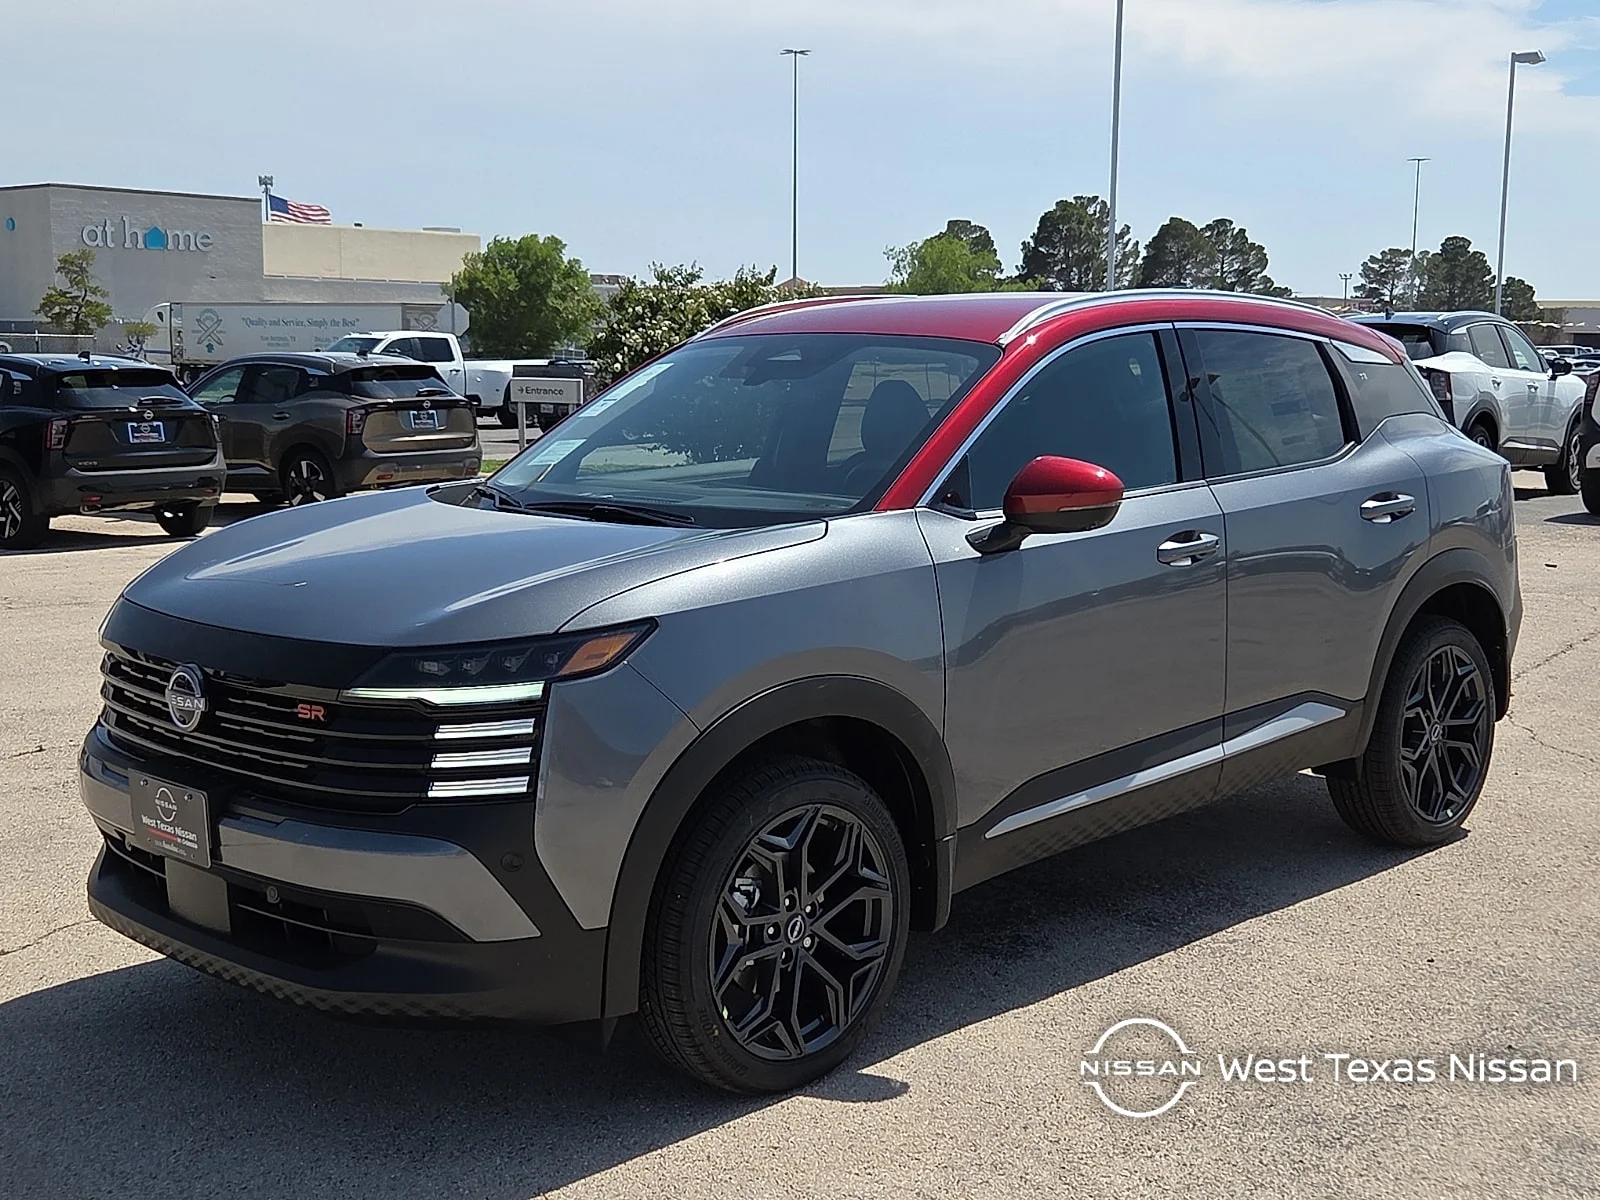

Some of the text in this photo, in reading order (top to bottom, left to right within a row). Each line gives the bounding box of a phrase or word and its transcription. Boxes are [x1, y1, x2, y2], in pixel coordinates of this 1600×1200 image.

[81, 217, 116, 248] at
[268, 317, 281, 327] and
[306, 317, 329, 329] Simply
[329, 316, 341, 327] the
[525, 386, 564, 396] Entrance
[297, 703, 327, 722] SR
[155, 798, 177, 811] NISSAN
[141, 814, 198, 842] West Texas Nissan
